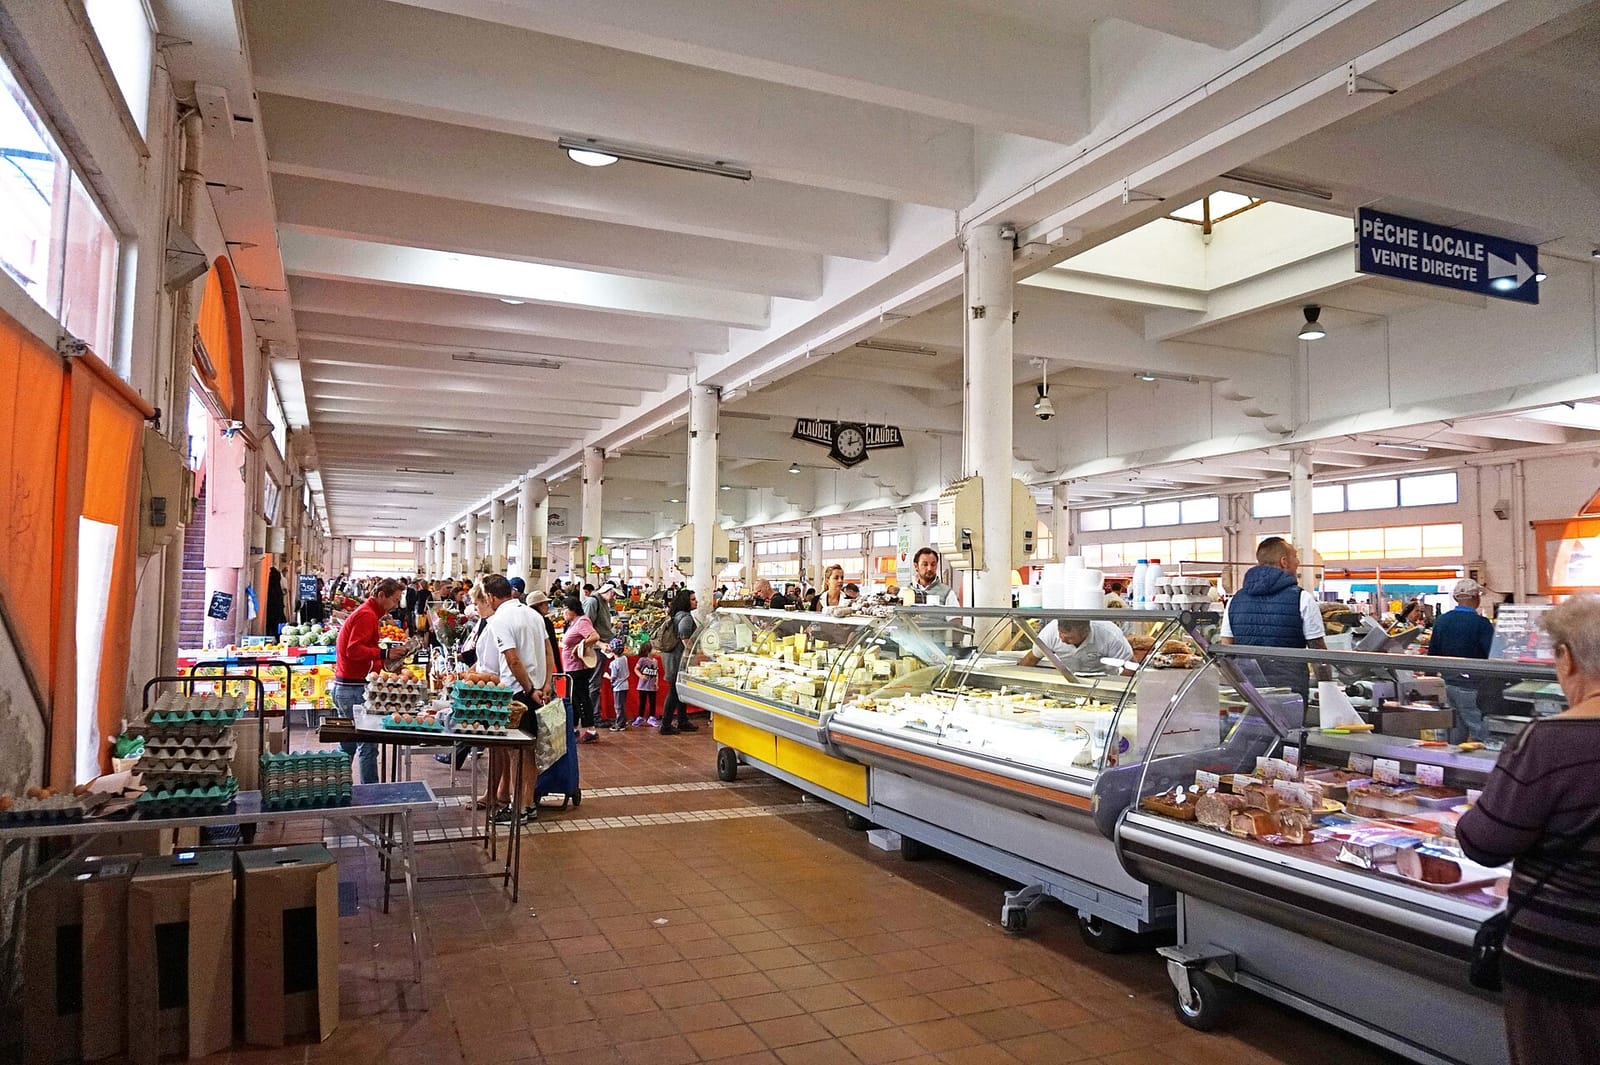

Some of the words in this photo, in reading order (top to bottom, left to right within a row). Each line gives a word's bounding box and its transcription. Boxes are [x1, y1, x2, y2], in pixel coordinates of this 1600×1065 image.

[1362, 217, 1419, 248] PÊCHE
[1423, 232, 1484, 262] LOCALE
[1371, 247, 1418, 271] VENTE
[1421, 257, 1478, 282] DIRECTE
[797, 420, 833, 441] CLAUDEL
[865, 426, 899, 444] CLAUDEL
